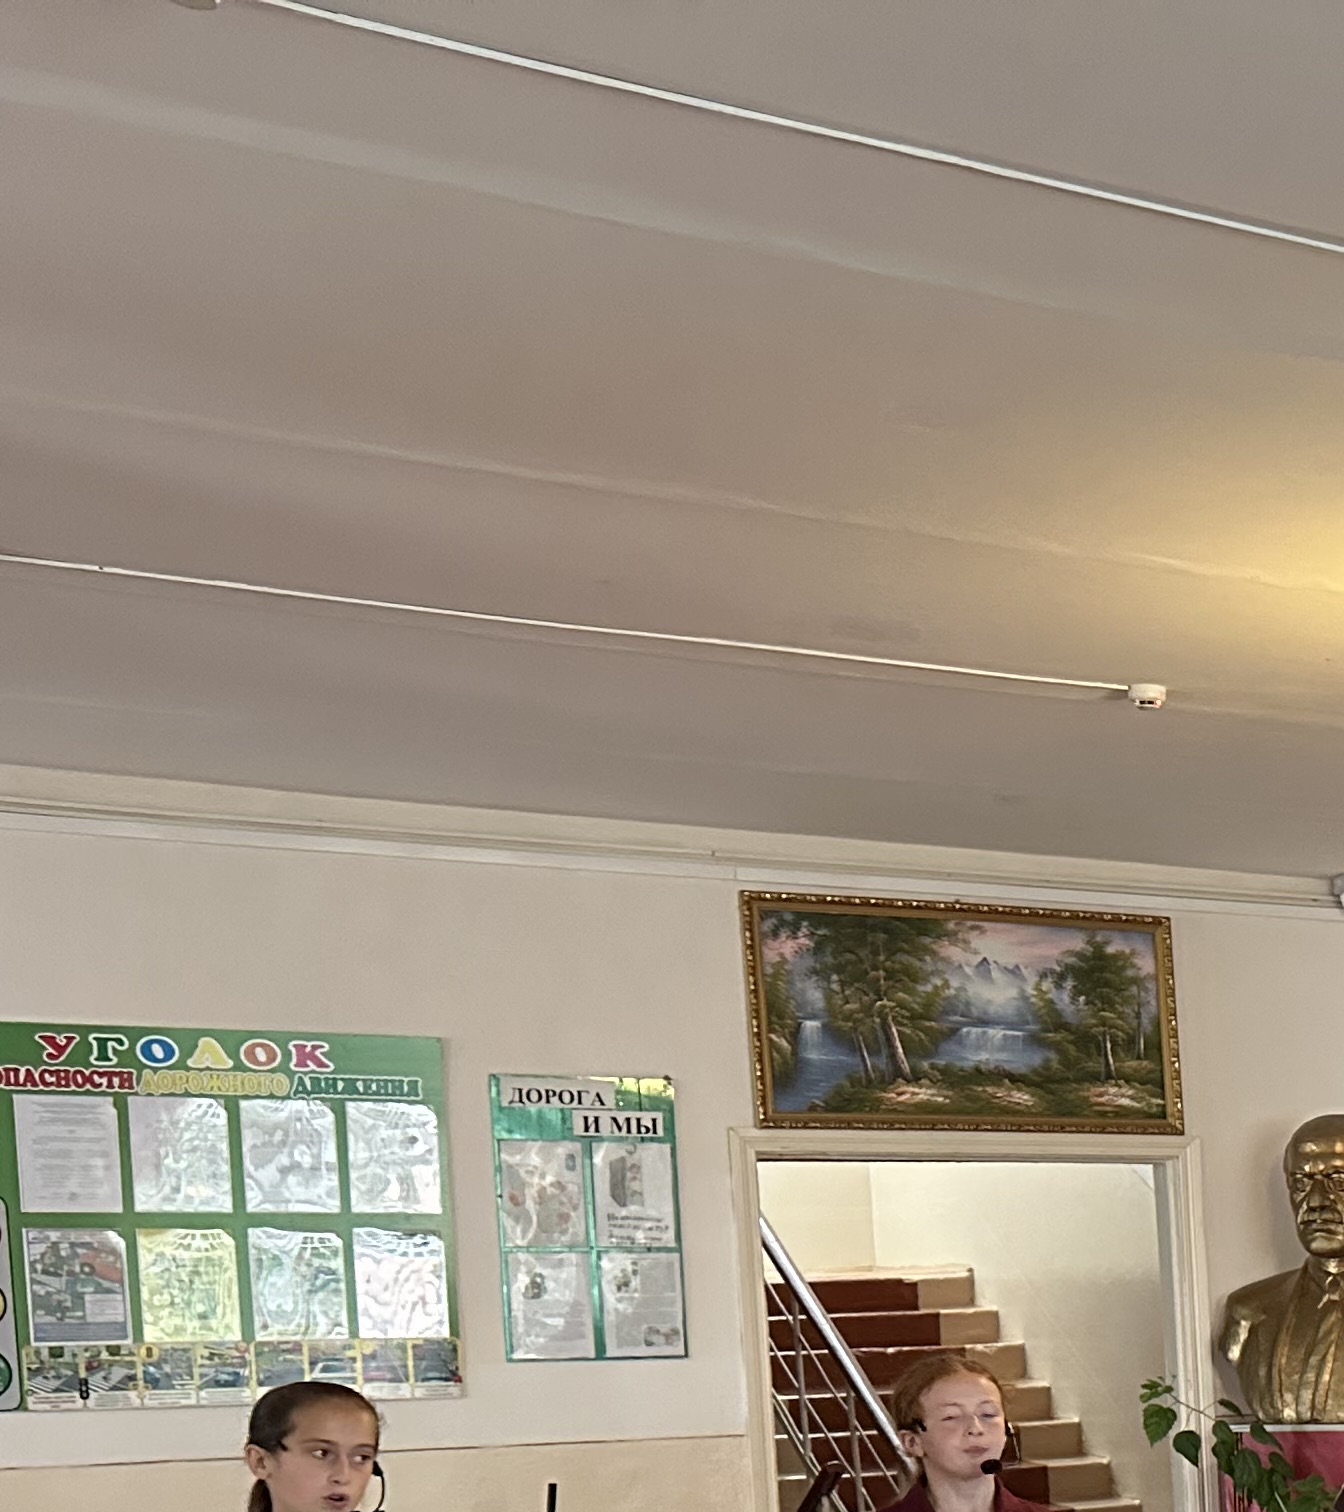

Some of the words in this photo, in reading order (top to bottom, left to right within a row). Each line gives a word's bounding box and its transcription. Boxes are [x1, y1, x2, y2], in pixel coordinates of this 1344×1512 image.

[35, 1033, 334, 1071] УГОЛОК
[0, 1065, 138, 1092] ПАСНОСТИ
[138, 1069, 290, 1097] ДОРОЖНОГО
[508, 1086, 607, 1107] ДОРОГА
[582, 1115, 600, 1134] И
[609, 1116, 659, 1136] МЫ
